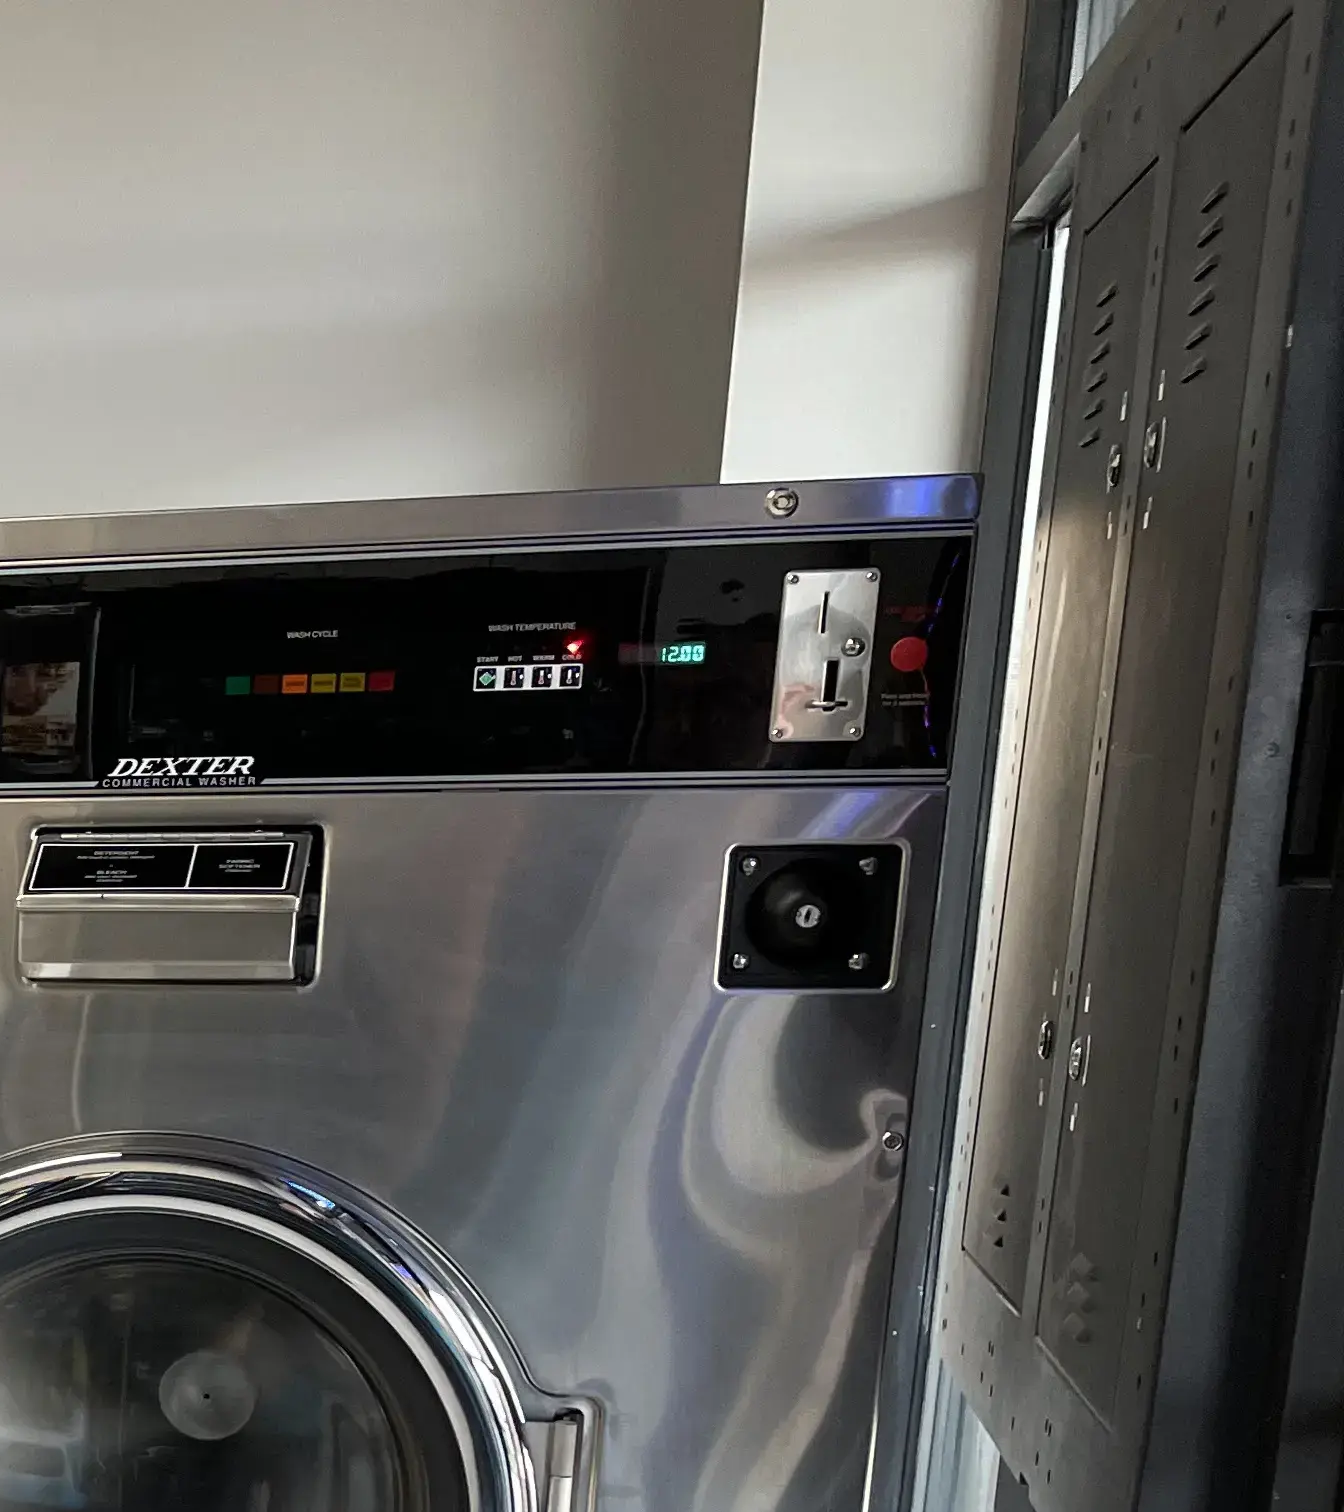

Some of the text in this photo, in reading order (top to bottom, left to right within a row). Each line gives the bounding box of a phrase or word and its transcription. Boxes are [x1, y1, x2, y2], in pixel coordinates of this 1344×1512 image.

[514, 622, 577, 631] TEMPERATURE
[312, 630, 339, 638] CYCLE
[107, 756, 255, 777] DEXTER
[102, 776, 256, 787] COMMERCIAL WASHER
